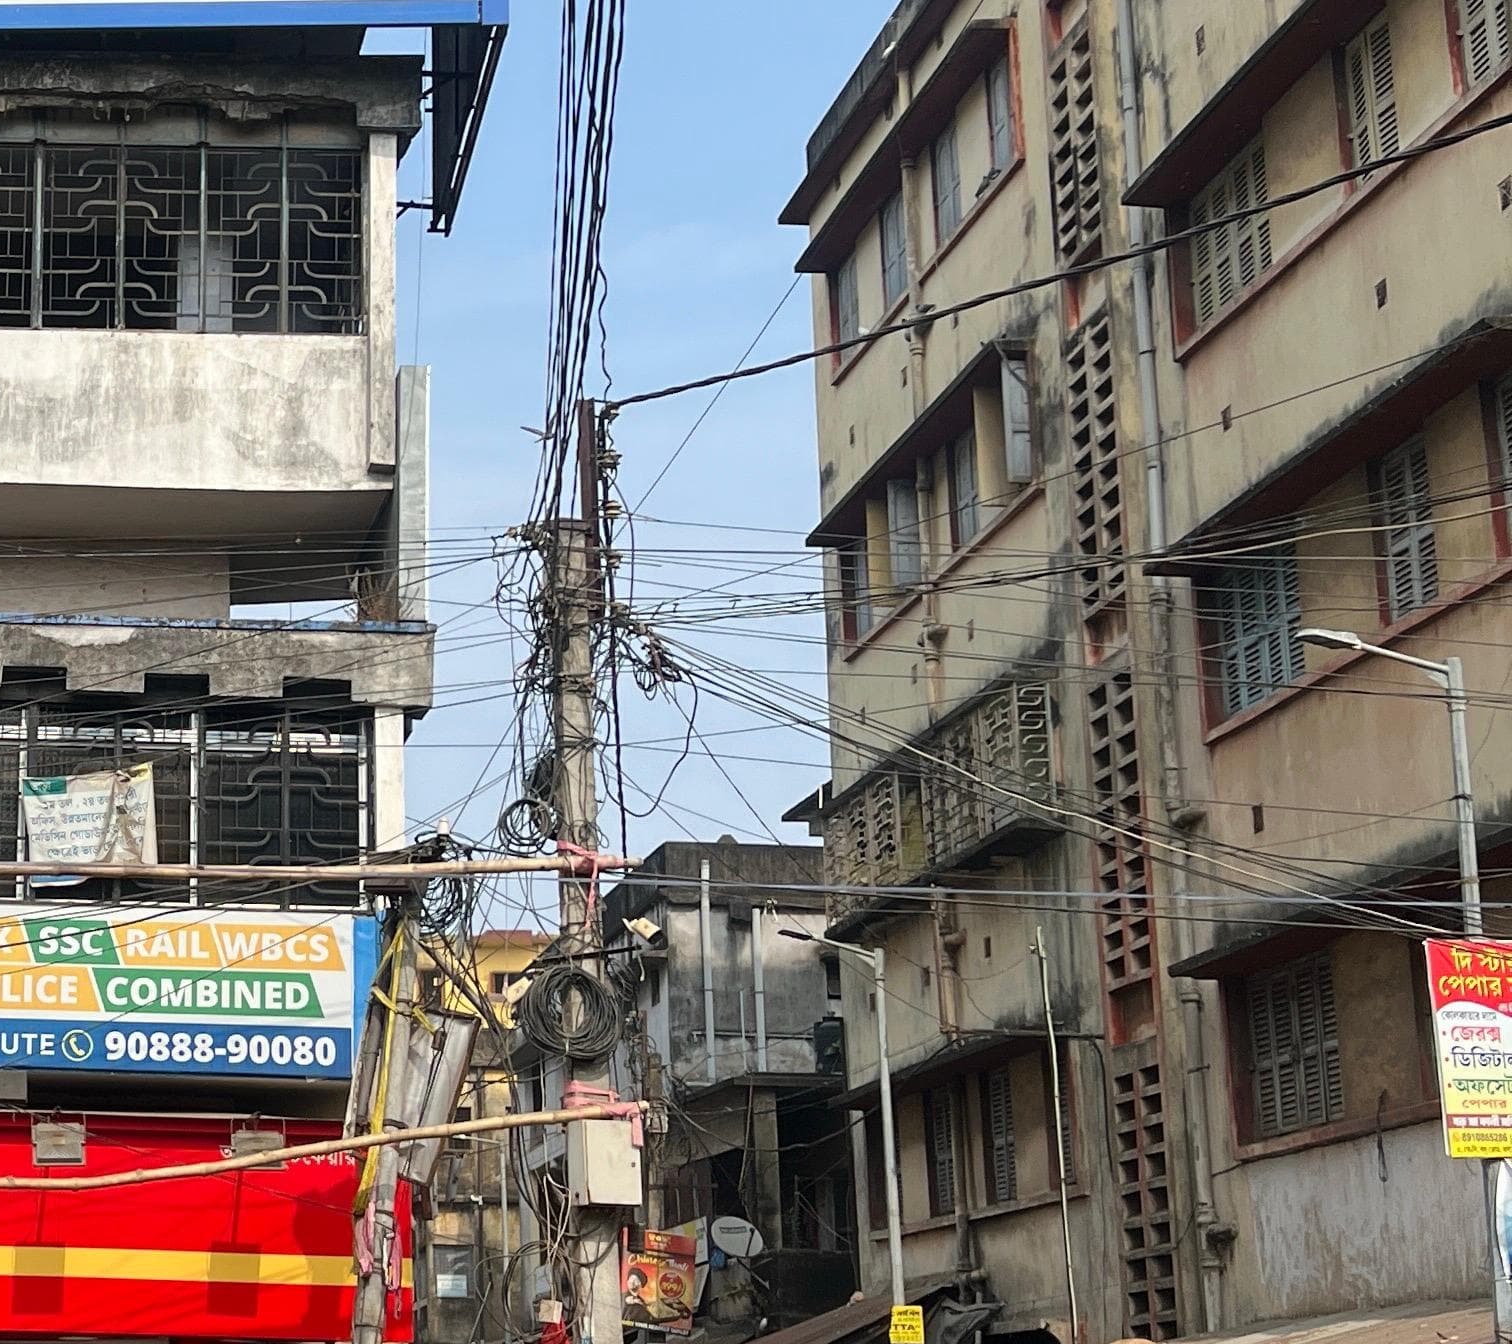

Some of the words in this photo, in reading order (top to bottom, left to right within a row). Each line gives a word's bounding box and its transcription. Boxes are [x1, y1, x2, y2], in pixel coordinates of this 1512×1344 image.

[38, 925, 105, 957] SSC
[125, 929, 211, 960] RAIL
[219, 931, 330, 963] WBCS
[105, 976, 311, 1010] COMBINED
[1439, 974, 1503, 997] পেপার
[104, 1031, 337, 1066] 90888-90080
